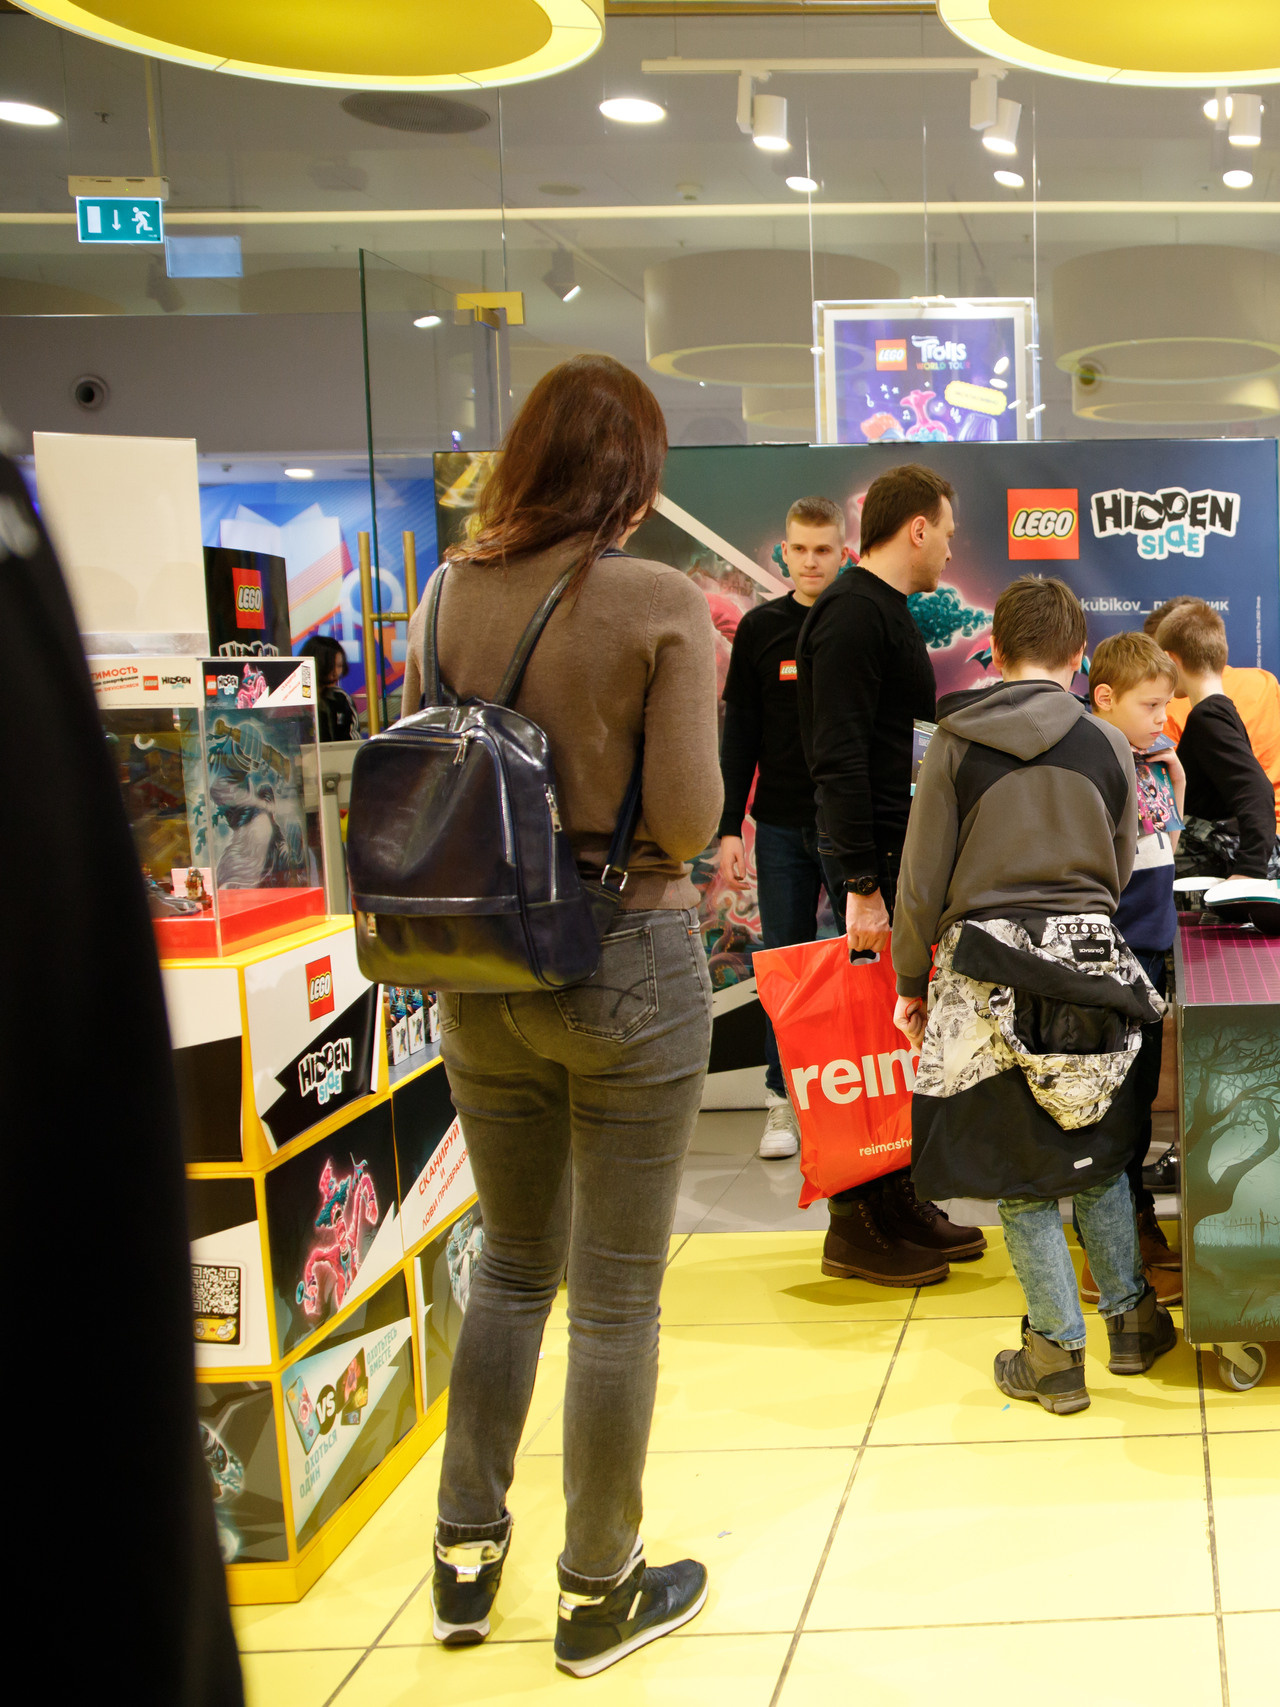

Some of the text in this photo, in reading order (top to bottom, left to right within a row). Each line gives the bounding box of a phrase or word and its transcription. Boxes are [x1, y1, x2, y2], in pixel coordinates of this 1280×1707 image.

[878, 334, 967, 363] LEGO Trolls
[916, 361, 946, 371] WORLD
[1012, 490, 1238, 537] LEGO HIDDEN
[1140, 524, 1201, 556] SIDE
[235, 584, 263, 613] LEGO
[161, 676, 191, 685] HIDDEN
[309, 973, 331, 1003] LEGO
[299, 1038, 352, 1096] HIDDEN
[791, 1048, 921, 1111] reim
[318, 1073, 342, 1104] SIDE
[418, 1122, 460, 1196] СКАНИРУЙ
[422, 1198, 439, 1231] ЛОВИ
[369, 1350, 392, 1378] ВМЕСТЕ
[316, 1392, 336, 1424] VS
[299, 1467, 322, 1499] ОДИН
